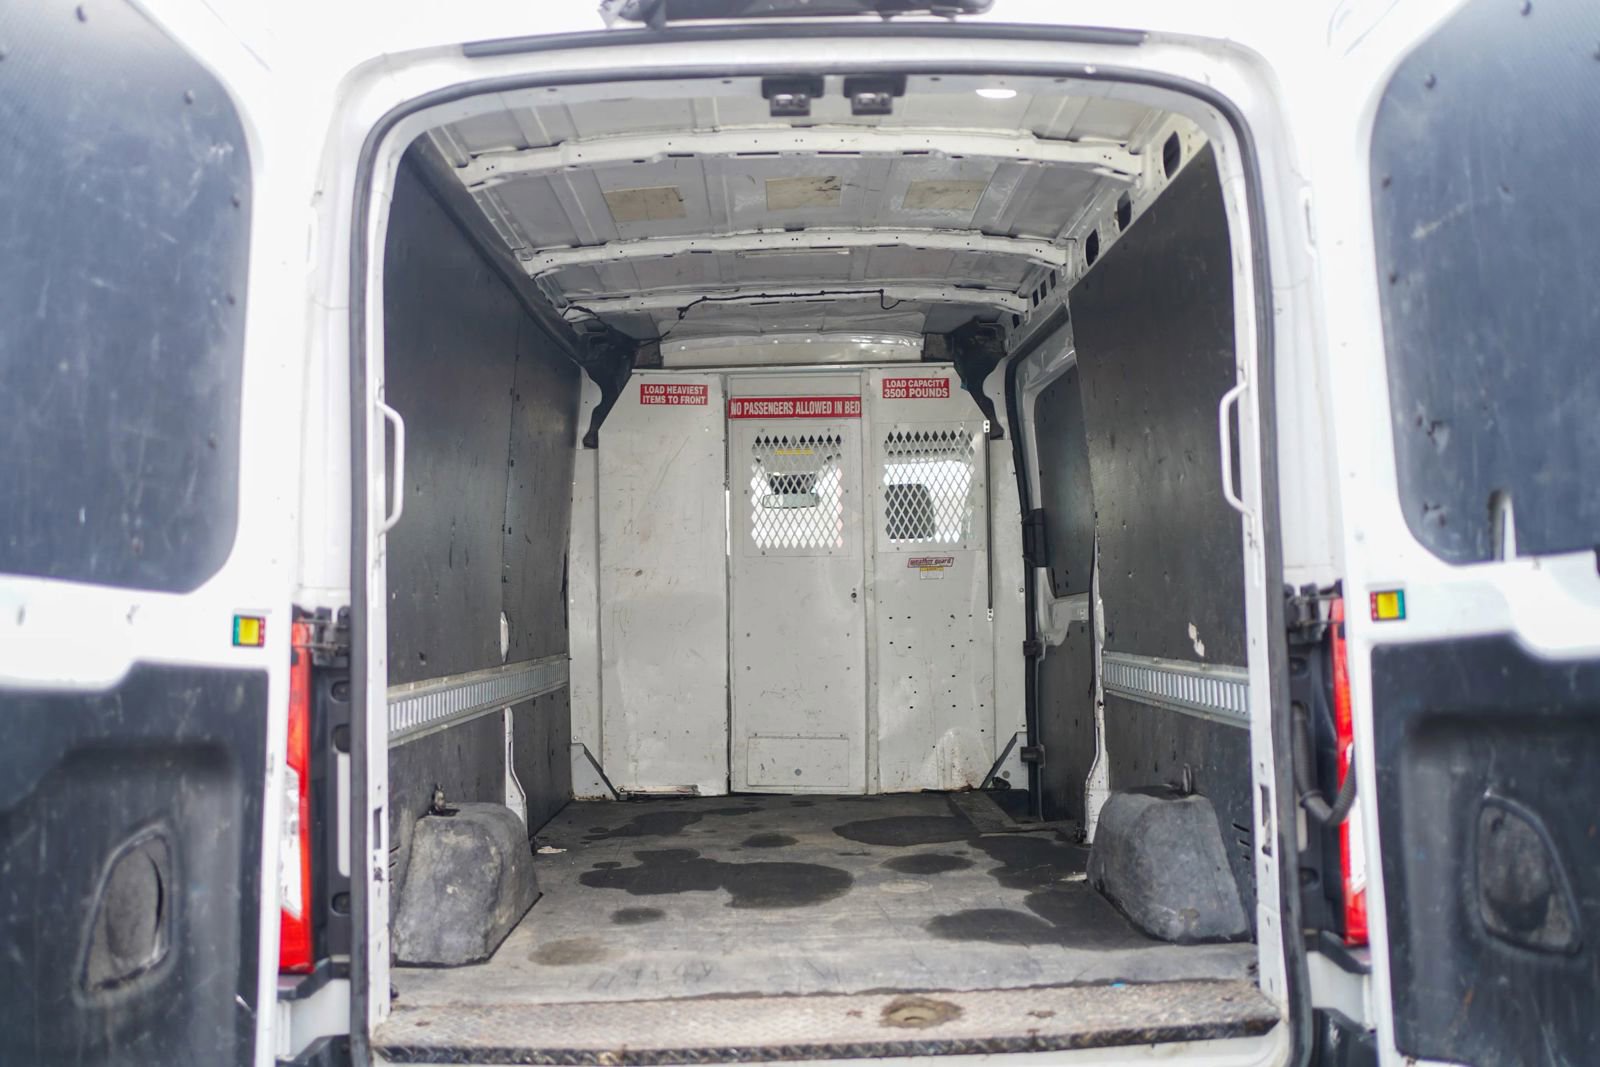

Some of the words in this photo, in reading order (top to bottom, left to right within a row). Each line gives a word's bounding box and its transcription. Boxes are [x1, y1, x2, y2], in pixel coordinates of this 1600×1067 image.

[886, 379, 906, 388] LOAD
[908, 379, 944, 387] CAPACITY
[644, 385, 665, 394] LOAD
[667, 385, 704, 395] HEAVIEST
[884, 388, 906, 398] 3500
[909, 388, 948, 398] POUNDS
[642, 395, 666, 404] ITEMS
[668, 395, 679, 404] TO
[680, 395, 706, 404] FRONT
[730, 401, 742, 416] NO
[743, 401, 794, 415] PASSENGERS
[795, 400, 832, 415] ALLOWED
[834, 400, 843, 414] IN
[845, 400, 860, 414] BED
